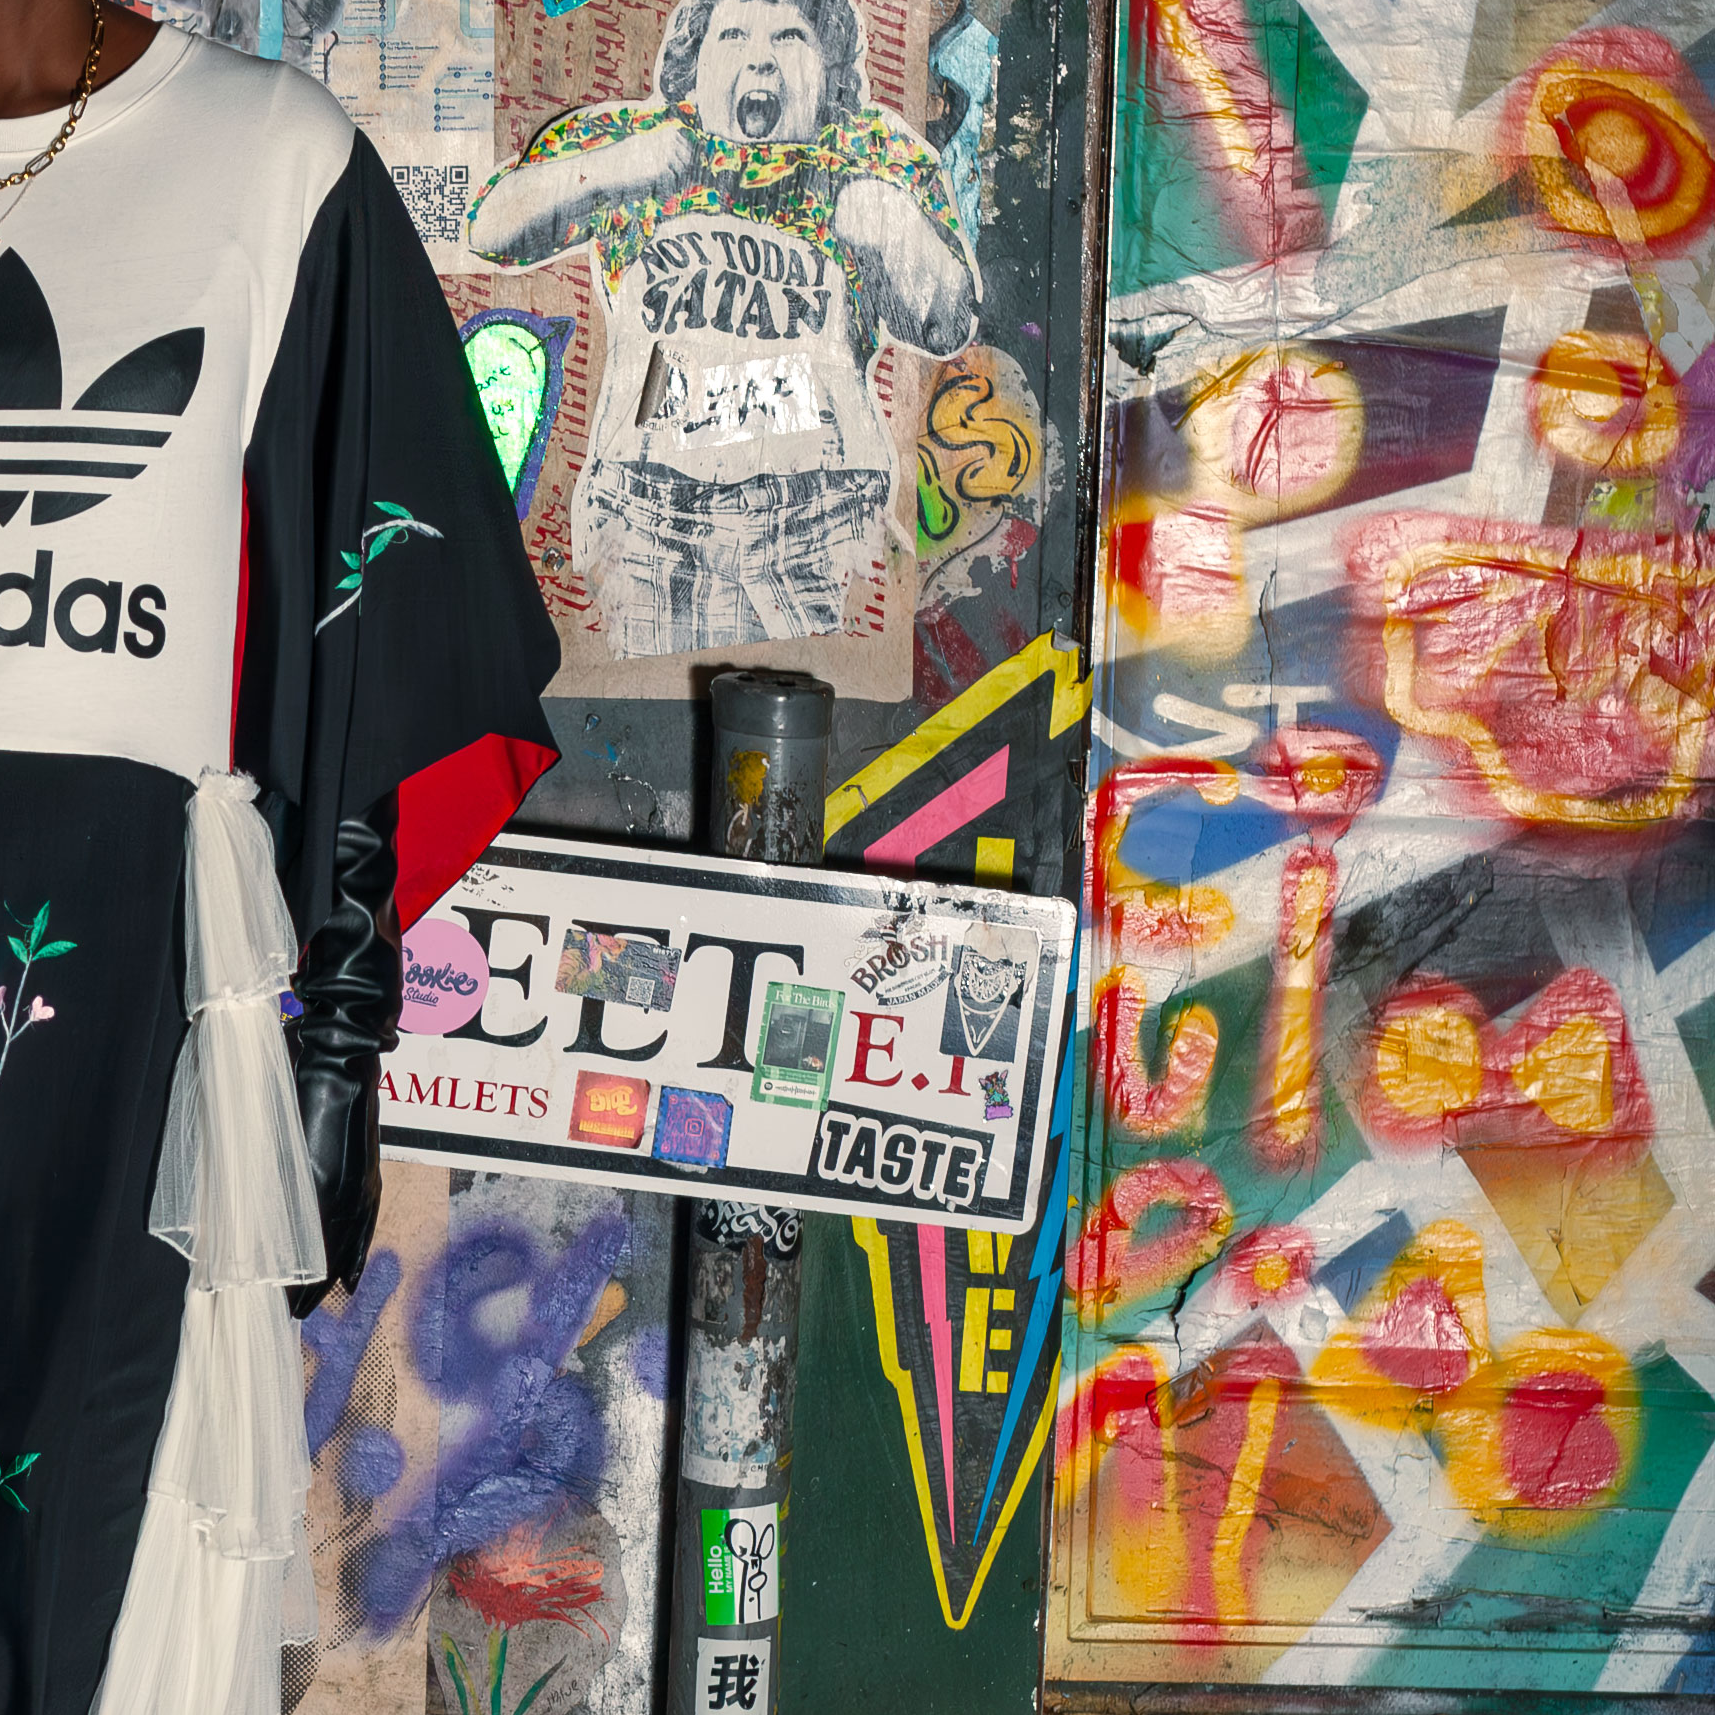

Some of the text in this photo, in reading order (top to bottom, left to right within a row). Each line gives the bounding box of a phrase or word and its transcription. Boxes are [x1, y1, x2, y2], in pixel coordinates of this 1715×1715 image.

[641, 230, 825, 288] NOT TODAY
[641, 269, 834, 342] SATAN
[403, 987, 440, 1005] Studio
[792, 992, 812, 1005] The
[886, 994, 917, 1006] JAPAN
[378, 1070, 550, 1120] AMLETS
[819, 1110, 985, 1210] TASTE
[707, 1544, 725, 1595] Hello
